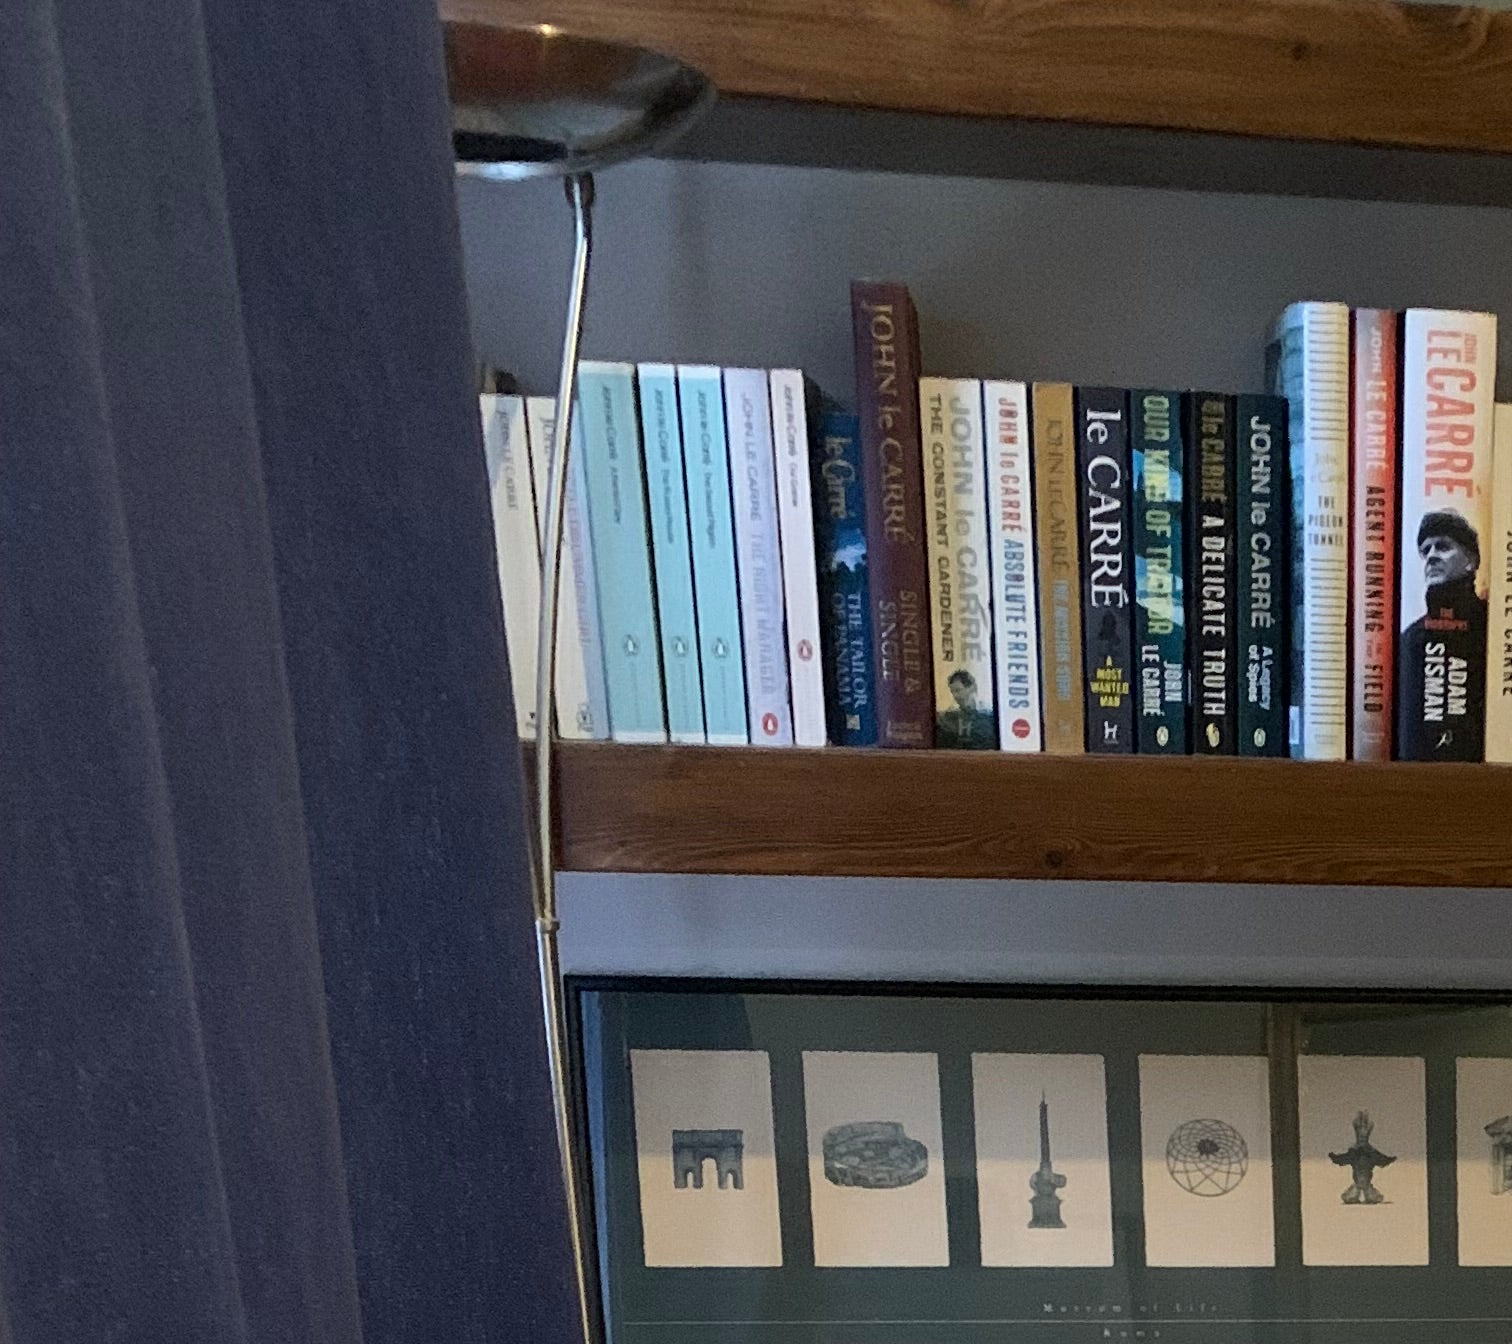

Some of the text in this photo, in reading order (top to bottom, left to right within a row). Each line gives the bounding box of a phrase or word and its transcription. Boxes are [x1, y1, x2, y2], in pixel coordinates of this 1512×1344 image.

[1370, 325, 1384, 375] JOHN
[741, 392, 756, 437] JOHN
[1143, 395, 1171, 443] OUR
[1365, 379, 1388, 403] LE
[1424, 328, 1483, 499] LE CARRÉ
[745, 441, 758, 461] LE
[860, 300, 917, 547] JOHN le CARRÉ
[1365, 409, 1389, 472] CARRÉ
[929, 392, 955, 663] THE CONSTANT GARDENER
[950, 396, 988, 663] JOHN le CARRÉ
[1085, 407, 1131, 610] le CARRÉ
[1145, 510, 1172, 539] OF
[1250, 415, 1277, 629] JOHN le CARRÉ
[1307, 514, 1344, 528] PIGEON
[1317, 495, 1336, 509] THE
[1365, 485, 1387, 543] AGENT
[998, 397, 1032, 710] JOHN le CARRÉ ABSOLUTE FRIENDS
[1308, 533, 1345, 548] TUNNEL
[1202, 515, 1227, 715] A DELICATE TRUTH
[1364, 550, 1387, 633] RUNNING
[757, 619, 778, 695] MANAGER
[832, 592, 852, 706] OF PANAMA
[847, 592, 869, 709] THE TAILOR
[879, 600, 900, 681] SINGLE
[900, 589, 924, 696] SINGLE &
[1106, 655, 1113, 666] A
[1262, 645, 1274, 657] A
[1096, 667, 1123, 681] MOST
[1100, 695, 1121, 708] MAN
[1141, 644, 1183, 718] JOHN LE CARRÉ
[1245, 661, 1260, 703] Spies
[1363, 664, 1385, 714] FIELD
[1423, 641, 1447, 722] SISMAN
[1447, 656, 1469, 716] ADAM
